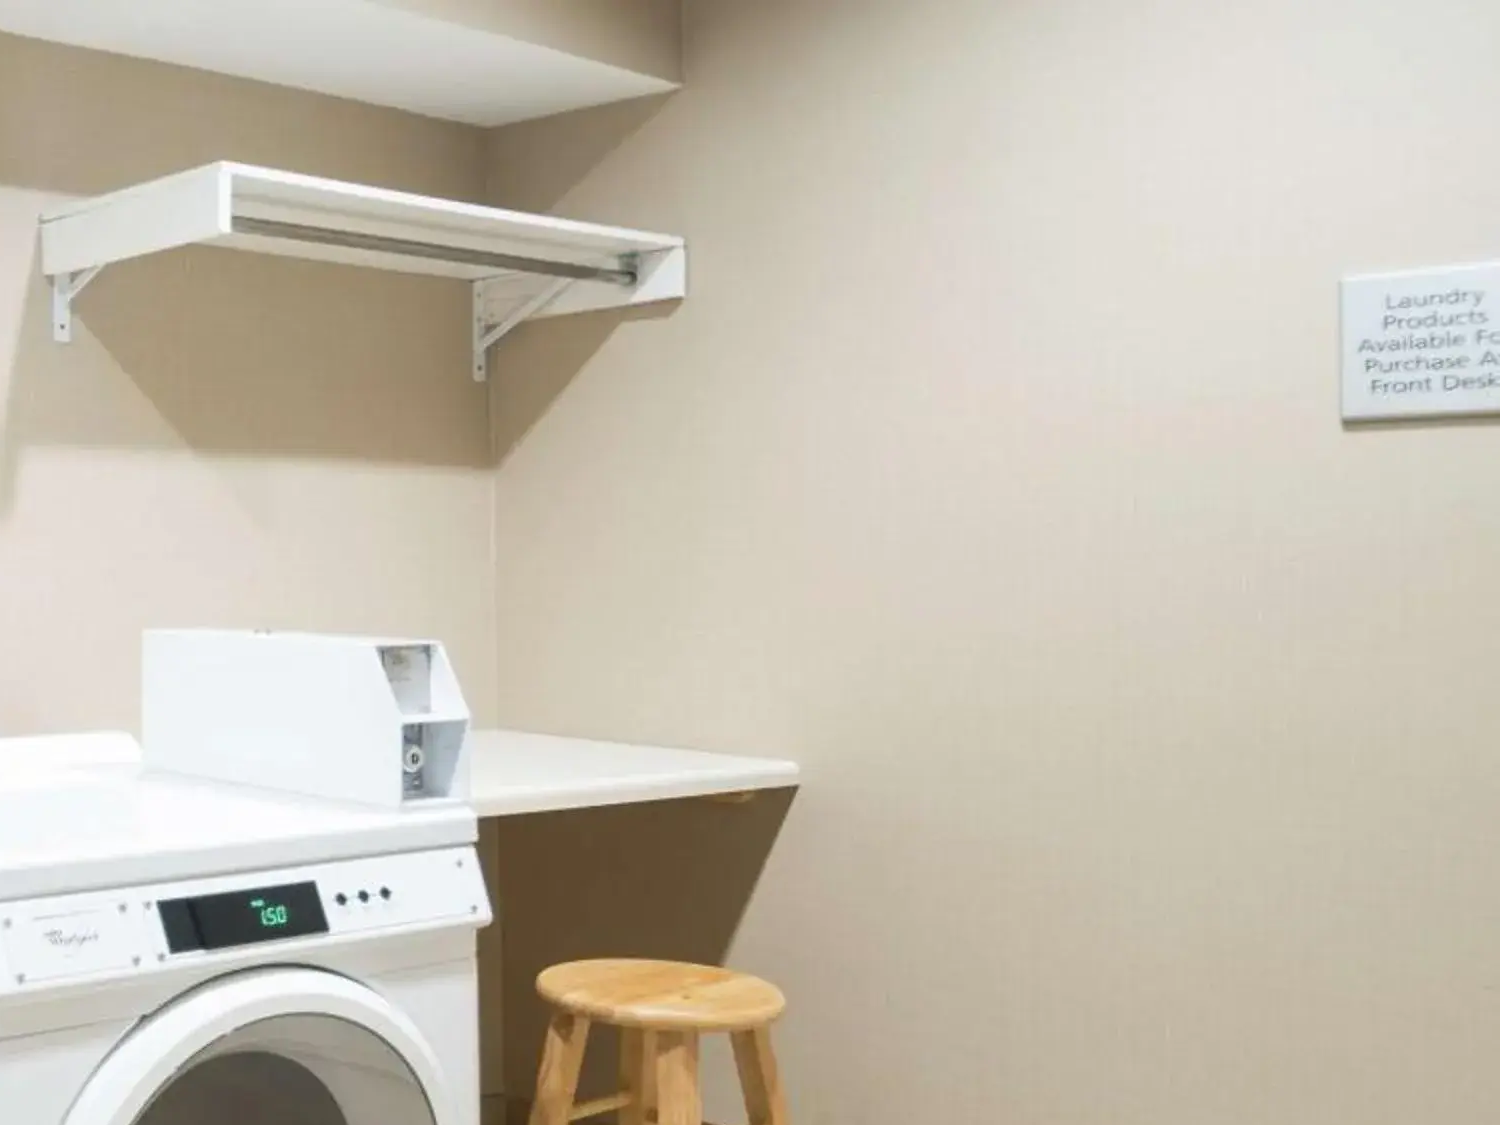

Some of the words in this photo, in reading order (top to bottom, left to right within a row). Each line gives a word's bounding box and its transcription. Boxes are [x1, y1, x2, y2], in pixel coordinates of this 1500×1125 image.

[1386, 289, 1485, 309] Laundry
[1382, 310, 1490, 330] Products
[1357, 331, 1465, 352] Available
[1364, 355, 1471, 373] Purchase
[1478, 350, 1500, 366] A
[1370, 377, 1432, 395] Front
